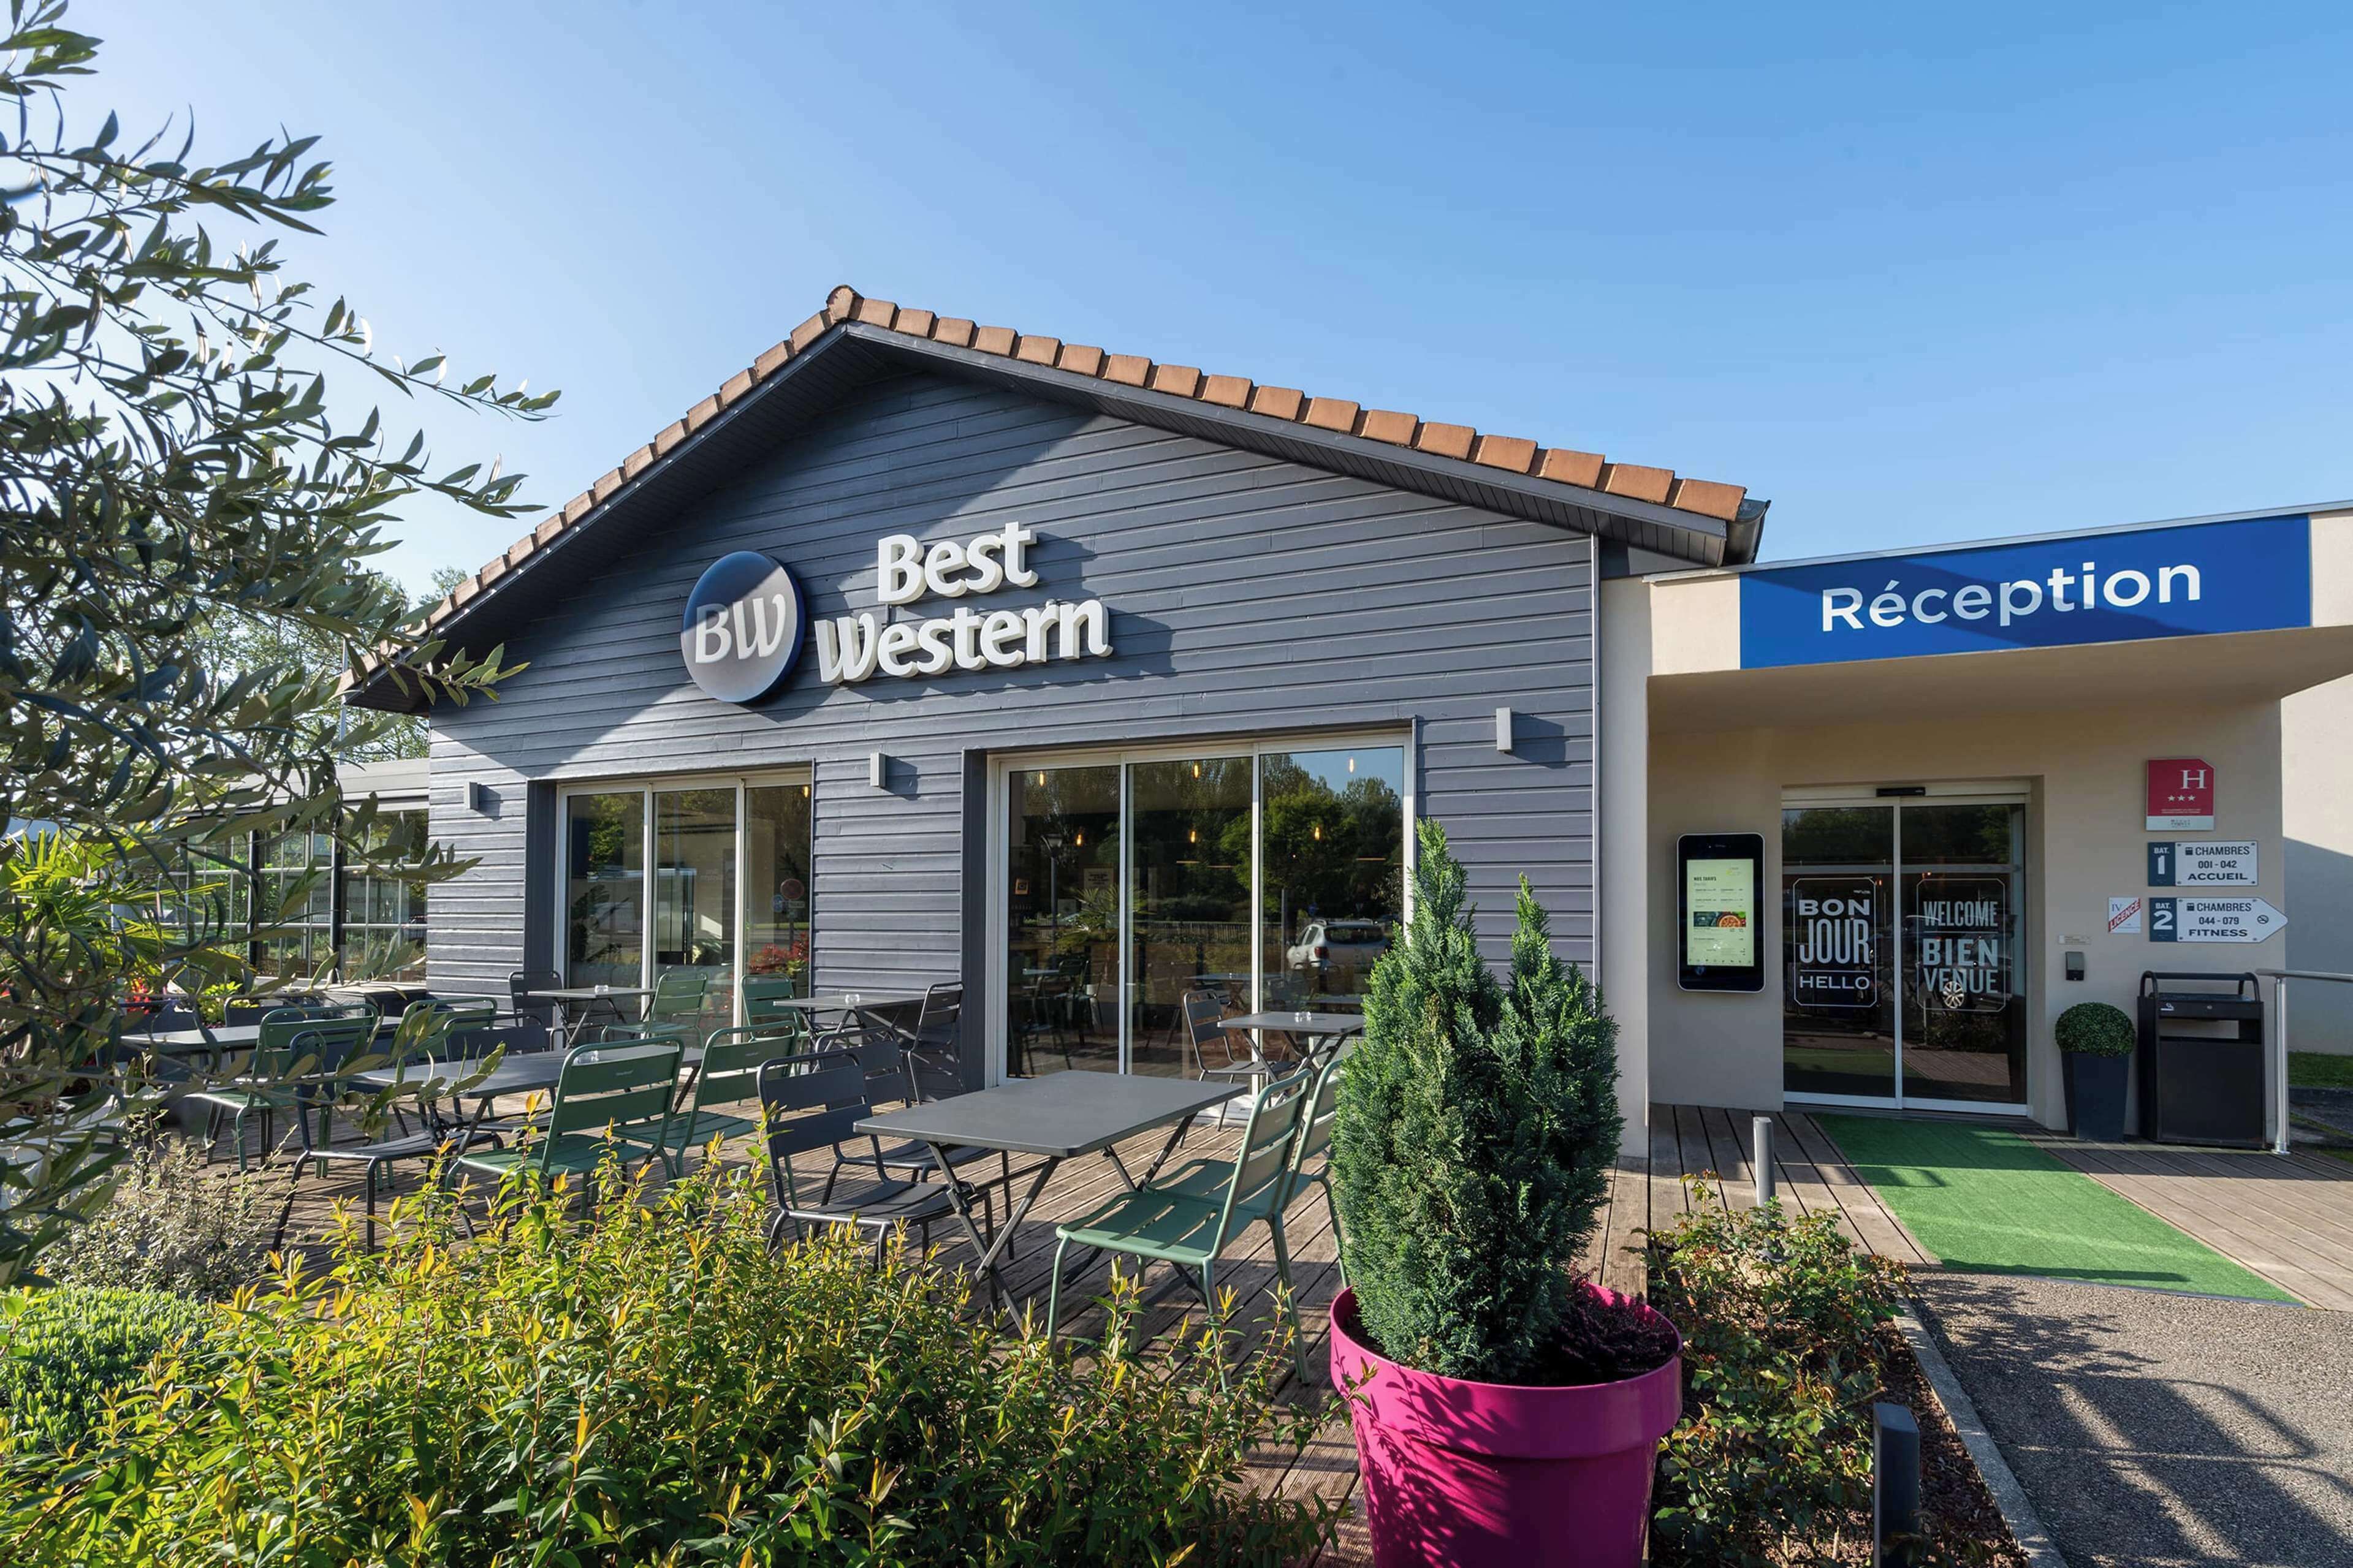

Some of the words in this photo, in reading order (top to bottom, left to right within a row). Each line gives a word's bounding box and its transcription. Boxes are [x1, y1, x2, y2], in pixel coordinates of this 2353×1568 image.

[878, 521, 1038, 605] Best
[1822, 561, 2200, 632] Réception
[695, 594, 786, 664] BW
[815, 598, 1114, 684] Western
[2180, 770, 2207, 789] H
[2195, 846, 2250, 856] CHAMBRES
[2157, 855, 2165, 874] 1
[2198, 860, 2213, 869] 001
[1798, 899, 1869, 915] BON
[1923, 901, 1998, 926] WELCOME
[2110, 901, 2139, 929] LICENCE
[2197, 903, 2251, 912] CHAMBRES
[2153, 910, 2173, 930] 2
[1800, 919, 1870, 964] JOUR
[1923, 938, 1998, 967] BIEN
[1800, 975, 1869, 990] HELLO
[1923, 968, 1999, 994] VENUE
